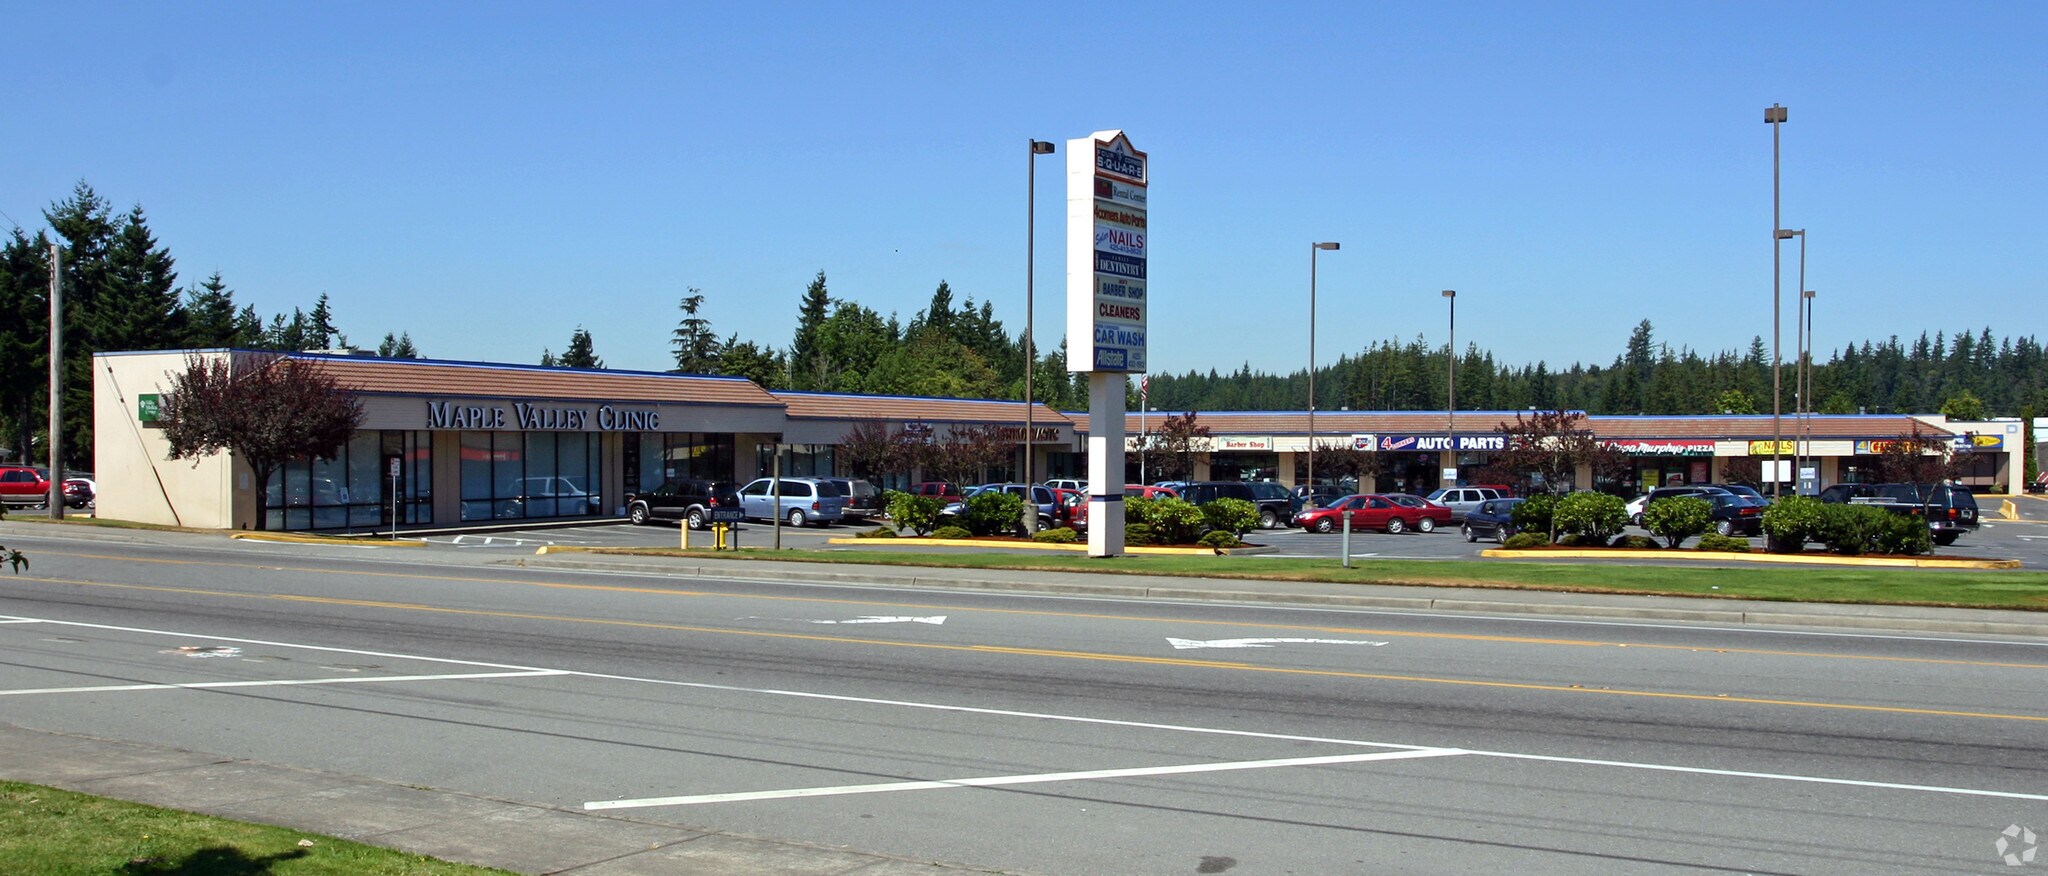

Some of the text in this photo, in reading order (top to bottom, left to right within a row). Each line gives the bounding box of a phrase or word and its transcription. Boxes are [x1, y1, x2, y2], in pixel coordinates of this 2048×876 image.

[1114, 185, 1129, 199] Rental
[1130, 190, 1146, 202] Center
[1119, 211, 1131, 225] Auto
[1131, 214, 1146, 228] Parts
[1109, 229, 1143, 249] NAILS
[1100, 259, 1139, 276] DENTISTRY
[1103, 283, 1126, 297] BARBER
[1128, 286, 1143, 300] SHOP
[1099, 303, 1140, 321] CLEANERS
[1095, 328, 1144, 347] CAR WASH
[1096, 349, 1124, 367] Allstate
[428, 401, 660, 430] MAPLE VALLEY CLINIC
[1249, 441, 1264, 449] Shop
[1381, 436, 1392, 450] 4
[1416, 437, 1454, 450] AUTO
[1460, 437, 1504, 450] PARTS
[1636, 441, 1687, 455] Murphy's
[1687, 444, 1714, 452] PIZZA
[714, 510, 738, 519] ENTRANCE
